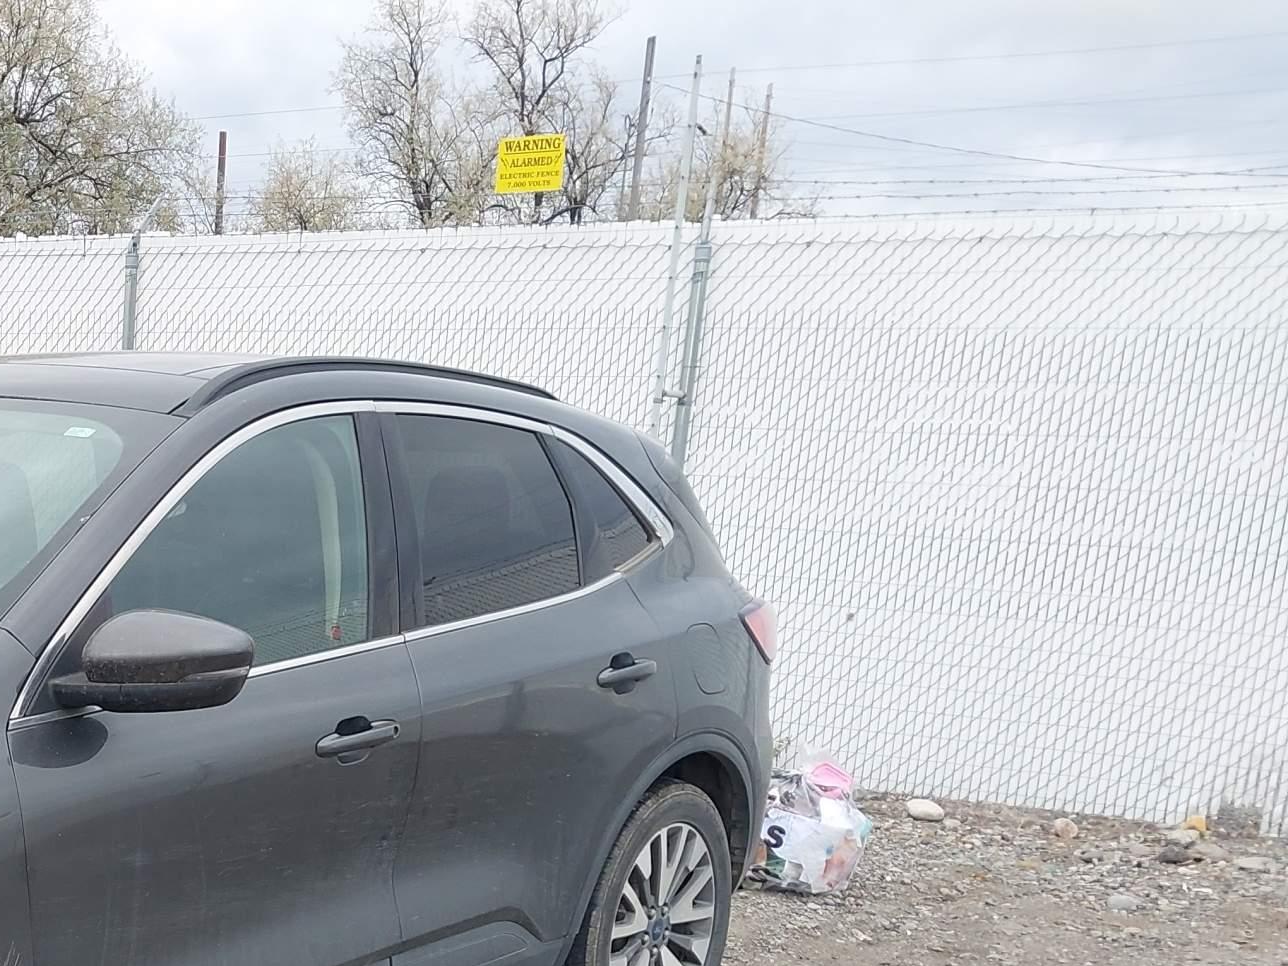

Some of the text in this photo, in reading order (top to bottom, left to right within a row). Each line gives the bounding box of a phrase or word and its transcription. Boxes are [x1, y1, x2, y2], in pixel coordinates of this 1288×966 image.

[504, 137, 562, 153] WARNING
[509, 156, 553, 168] ALARMED
[499, 170, 560, 180] ELECTRIC FENCE
[528, 179, 551, 187] VOLTS
